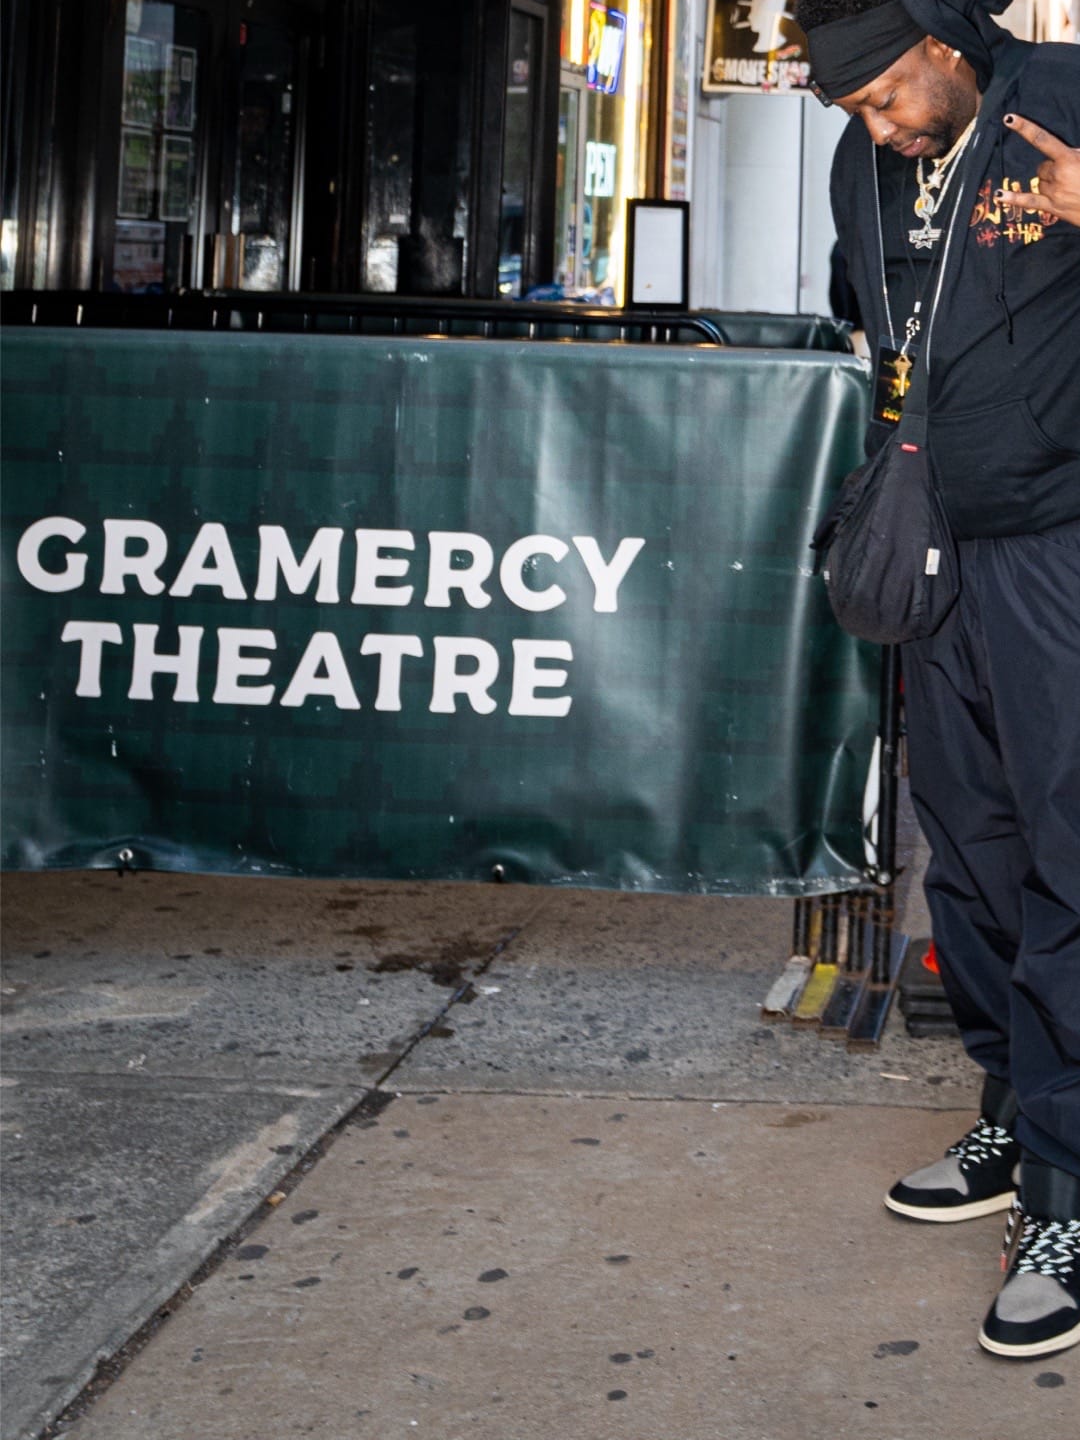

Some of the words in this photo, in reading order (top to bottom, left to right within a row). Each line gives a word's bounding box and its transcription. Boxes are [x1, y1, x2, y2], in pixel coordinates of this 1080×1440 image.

[713, 57, 766, 84] SMOKE
[16, 515, 645, 613] GRAMERCY
[60, 620, 573, 717] THEATRE
